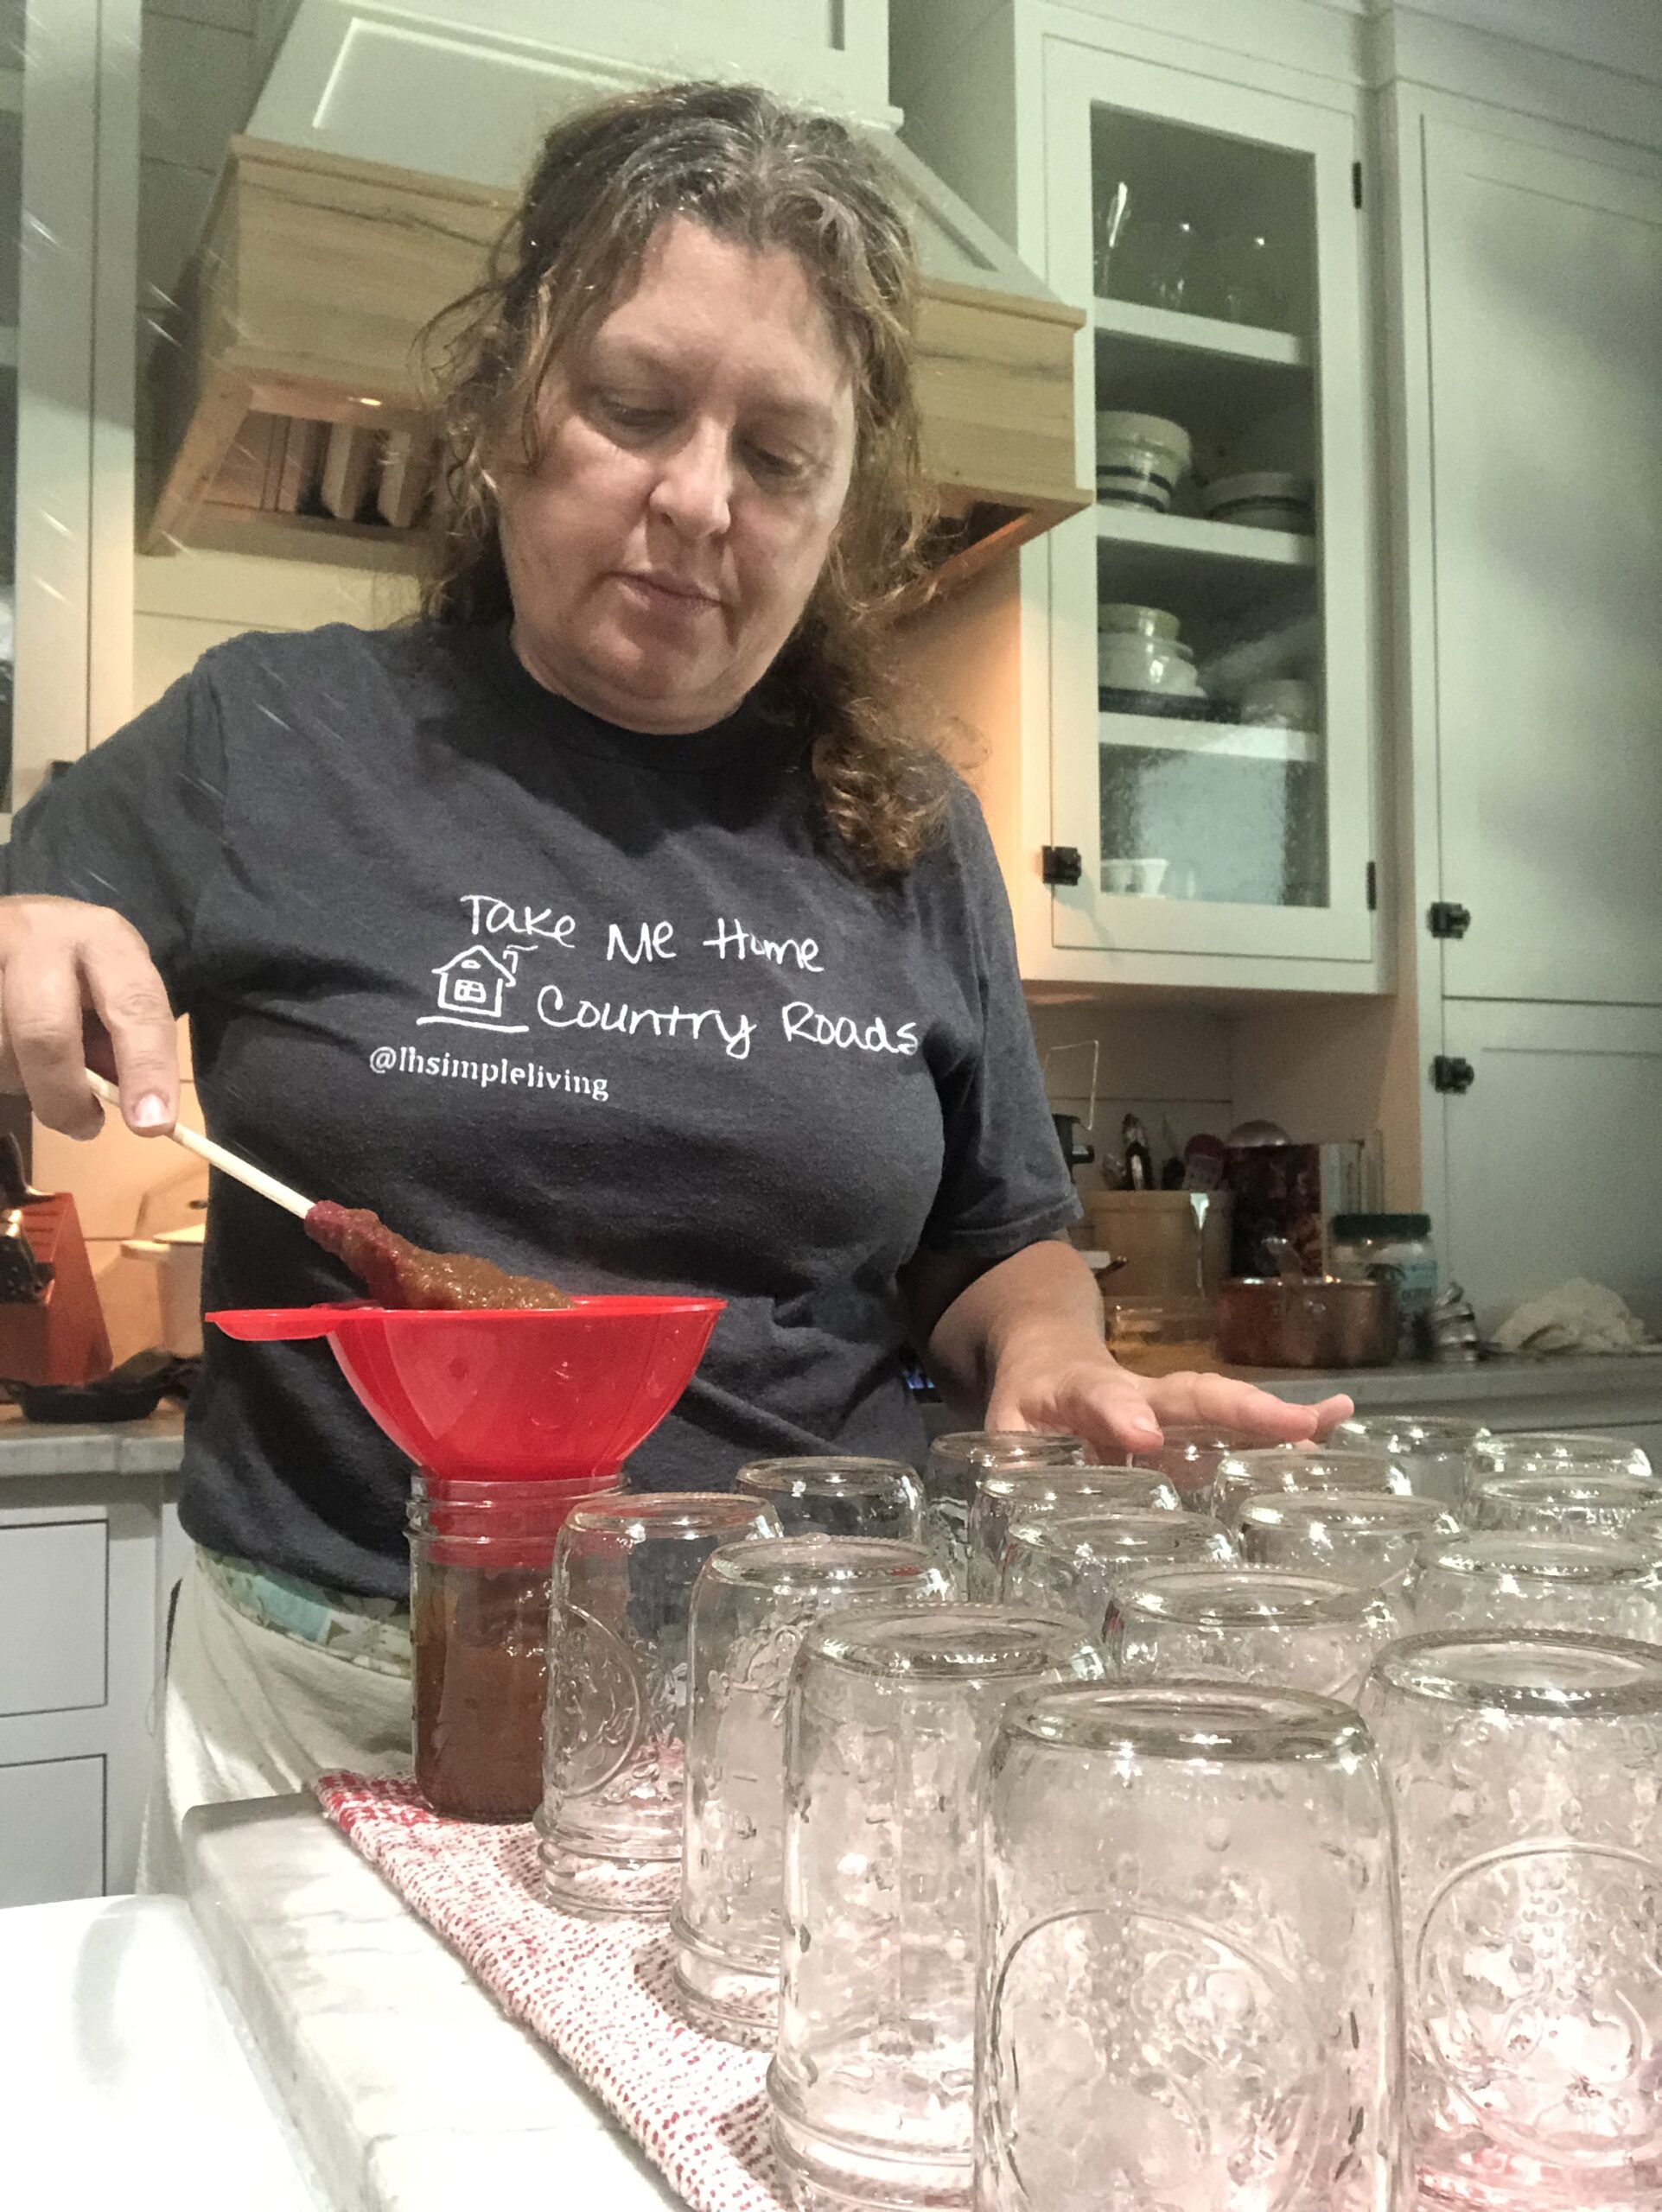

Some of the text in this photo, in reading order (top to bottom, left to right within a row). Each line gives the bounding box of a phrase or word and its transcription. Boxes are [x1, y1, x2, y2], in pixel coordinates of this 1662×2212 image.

[461, 895, 576, 949] Take
[607, 921, 677, 963] Me
[538, 985, 919, 1059] Country Roads
[370, 1046, 609, 1102] @lhsimpleliving
